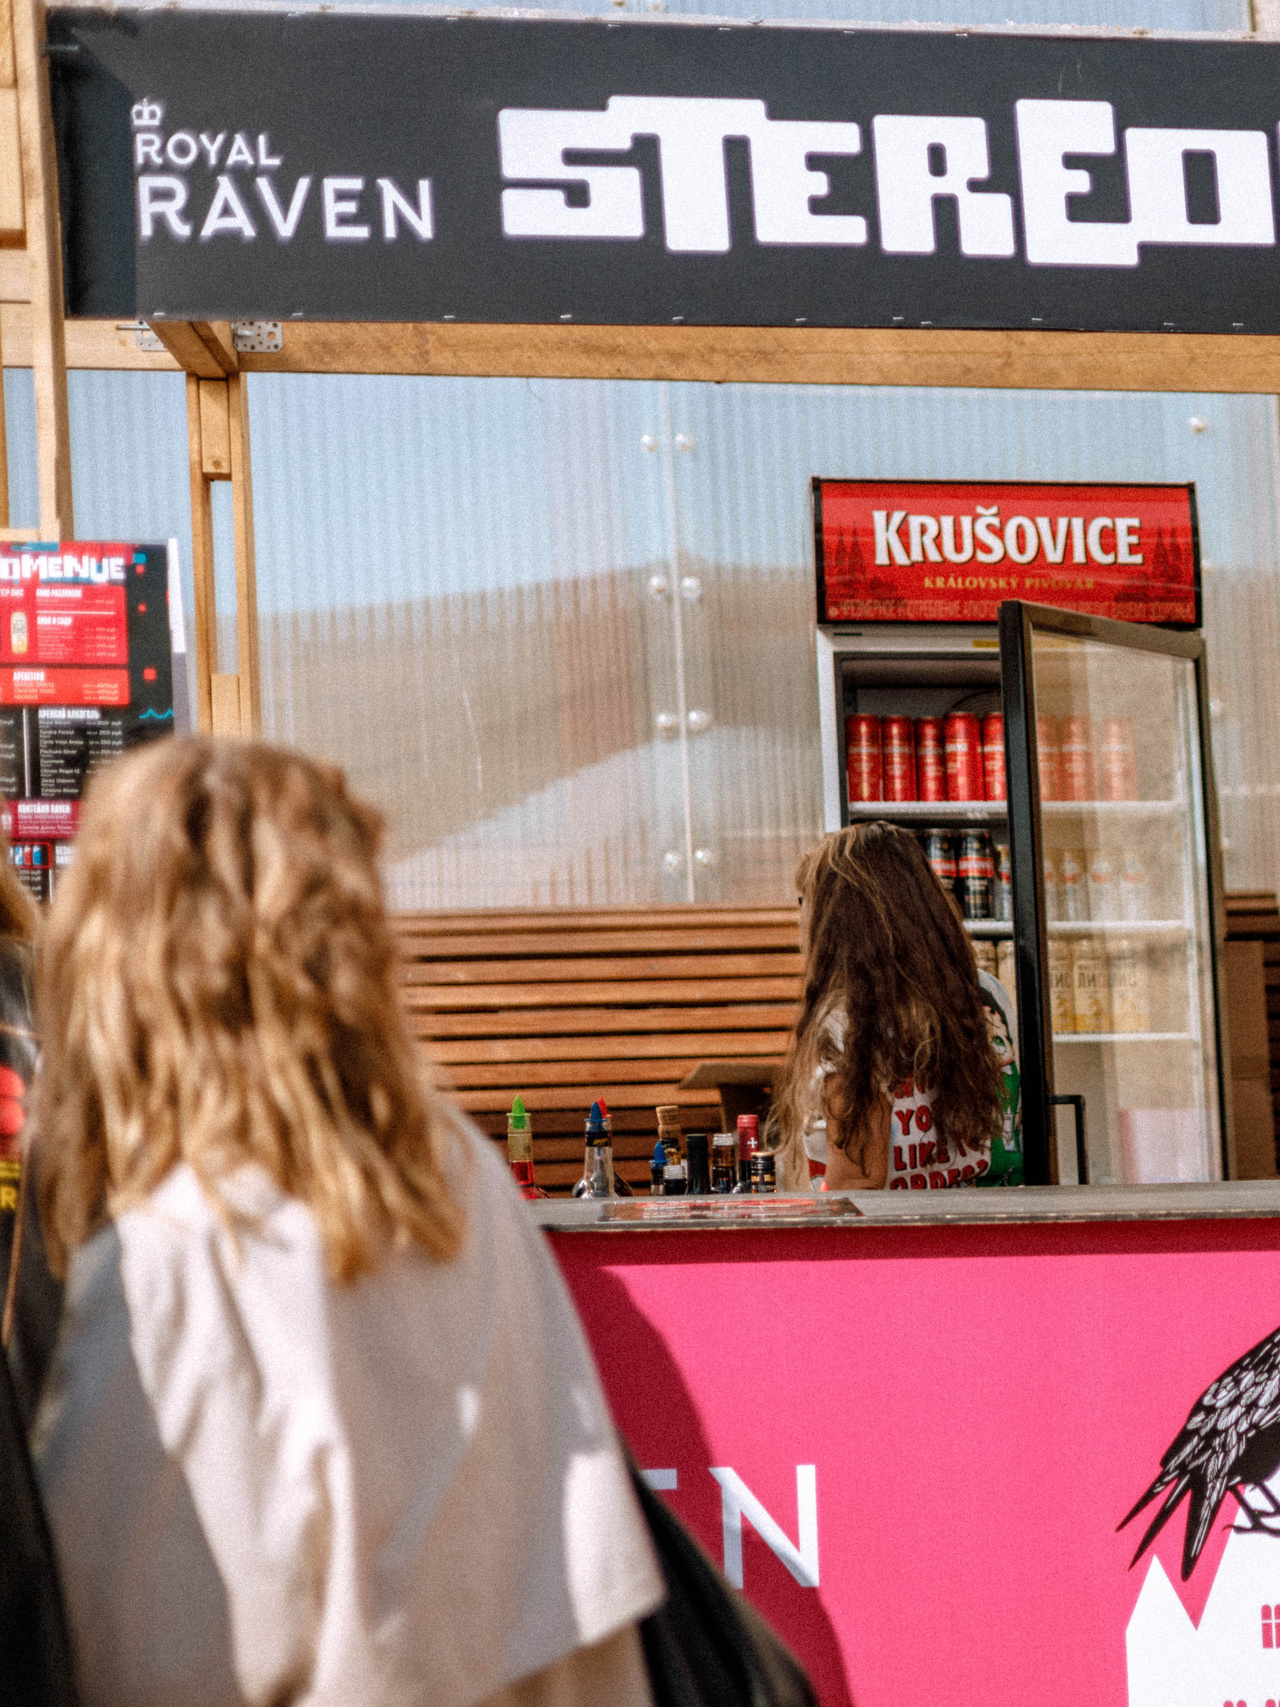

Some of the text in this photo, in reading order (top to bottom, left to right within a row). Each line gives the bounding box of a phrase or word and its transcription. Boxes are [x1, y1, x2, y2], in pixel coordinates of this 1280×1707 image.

[134, 131, 282, 166] ROYAL
[136, 175, 434, 240] RAVEN
[872, 505, 1144, 566] KRUŠOVICE
[1025, 577, 1094, 591] PIVOVAR
